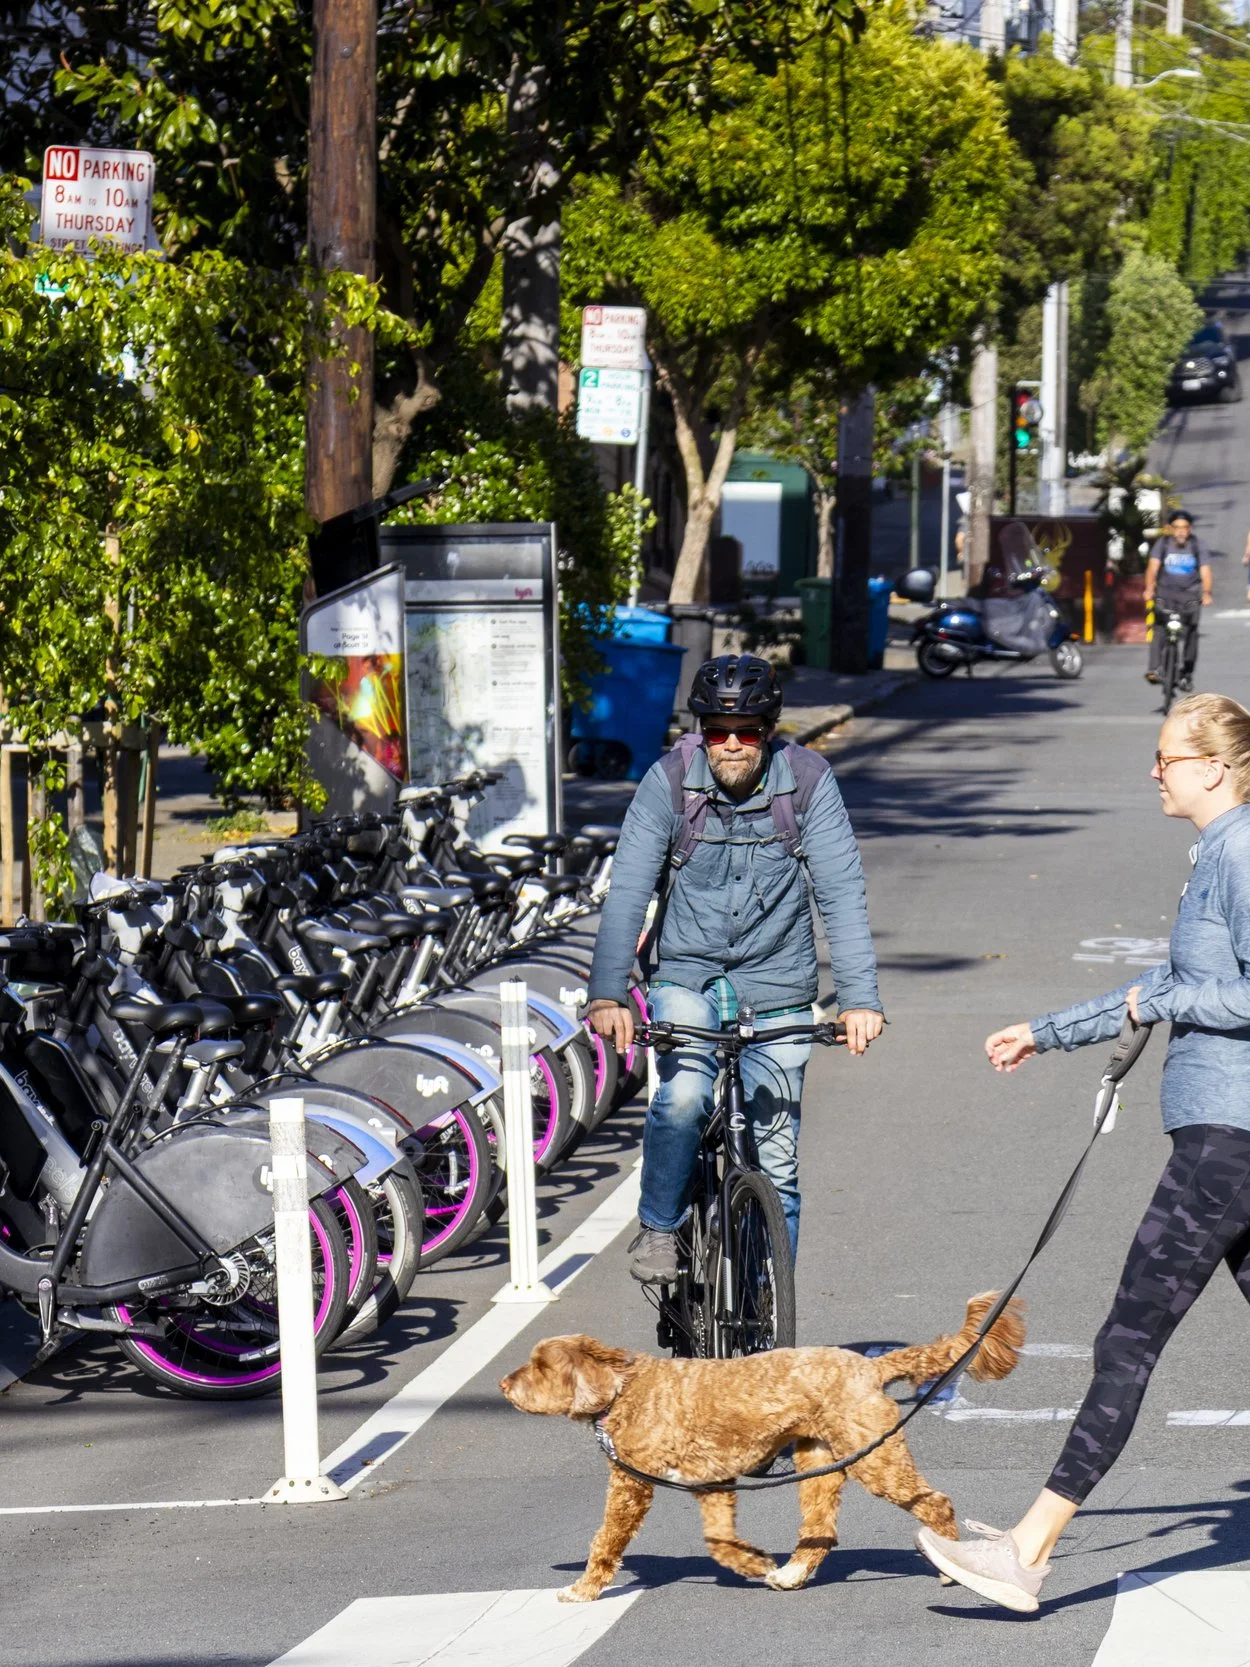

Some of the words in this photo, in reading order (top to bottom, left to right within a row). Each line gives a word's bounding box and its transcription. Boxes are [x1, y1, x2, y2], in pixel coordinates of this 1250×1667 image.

[49, 150, 77, 179] NO
[83, 160, 145, 182] PARKING
[56, 213, 136, 233] THURSDAY
[584, 371, 598, 387] 2
[416, 1074, 449, 1098] lyft
